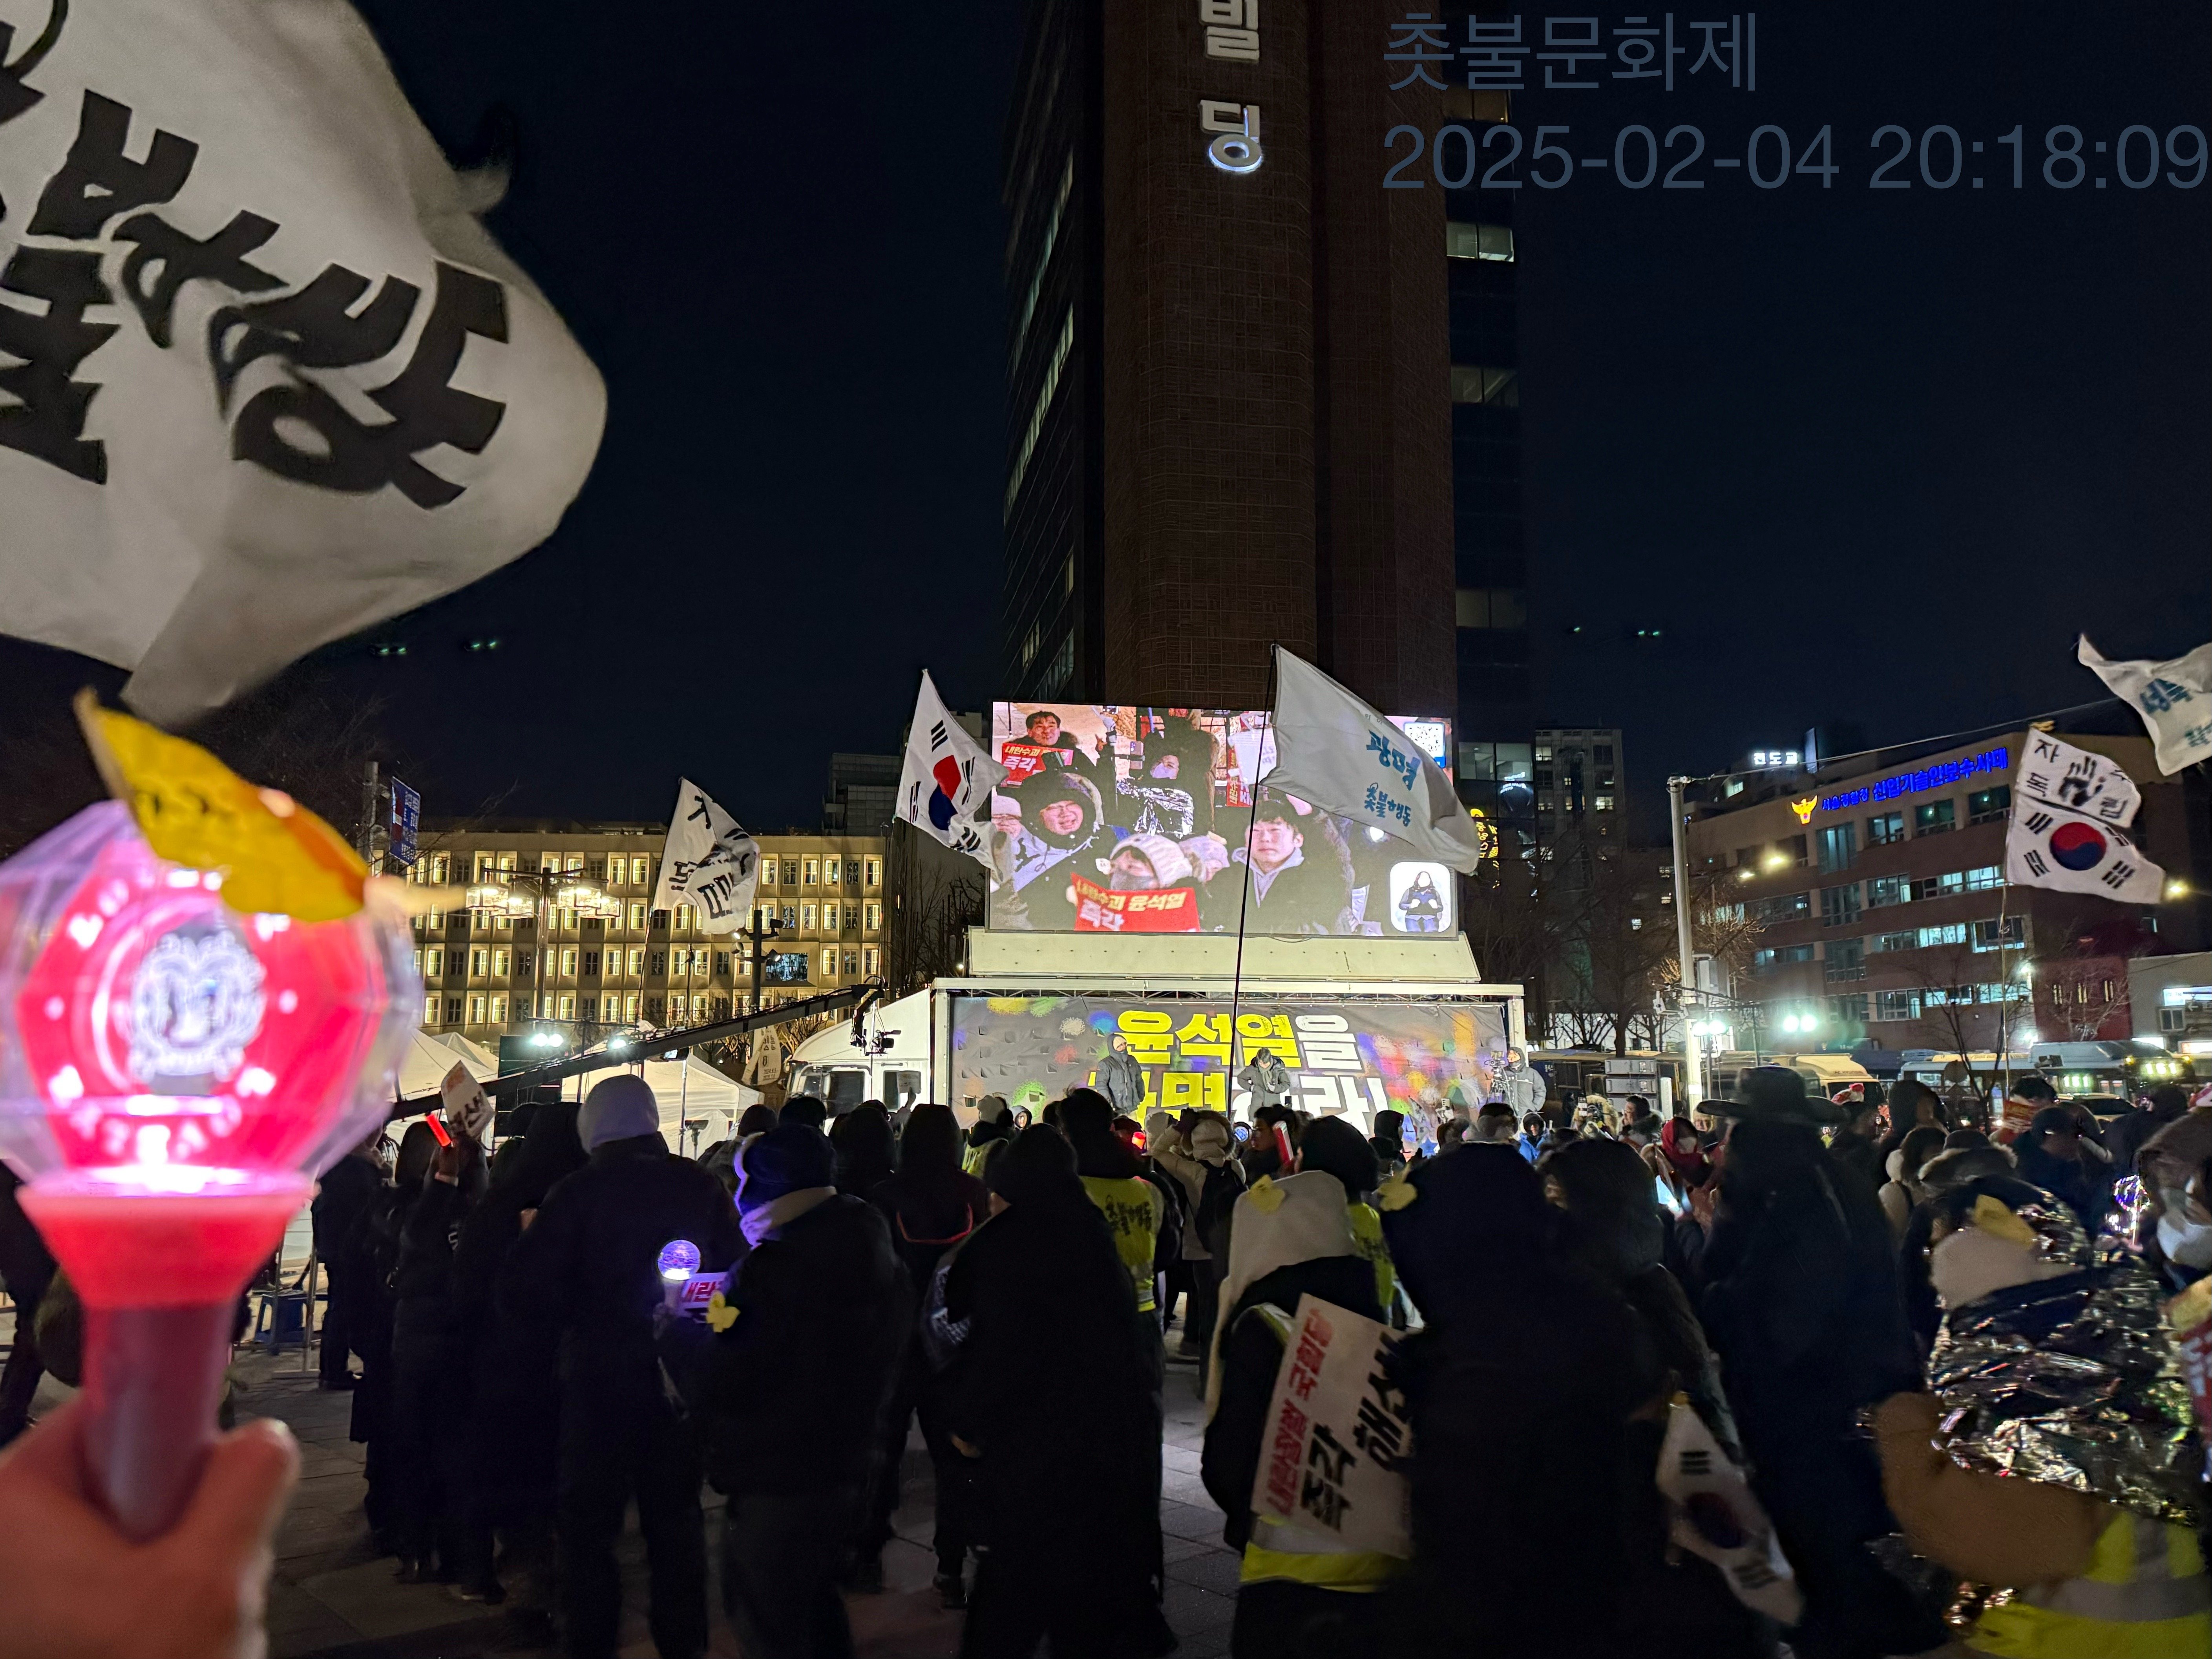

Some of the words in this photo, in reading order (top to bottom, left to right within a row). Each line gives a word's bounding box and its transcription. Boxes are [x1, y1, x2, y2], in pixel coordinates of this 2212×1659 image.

[1003, 755, 1037, 772] 즉각
[1754, 752, 1798, 765] 천도교
[1364, 784, 1411, 827] 촛불행동
[1128, 892, 1187, 912] 윤석열
[1113, 1010, 1363, 1071] 윤석열을
[1299, 1422, 1357, 1532] 즉각
